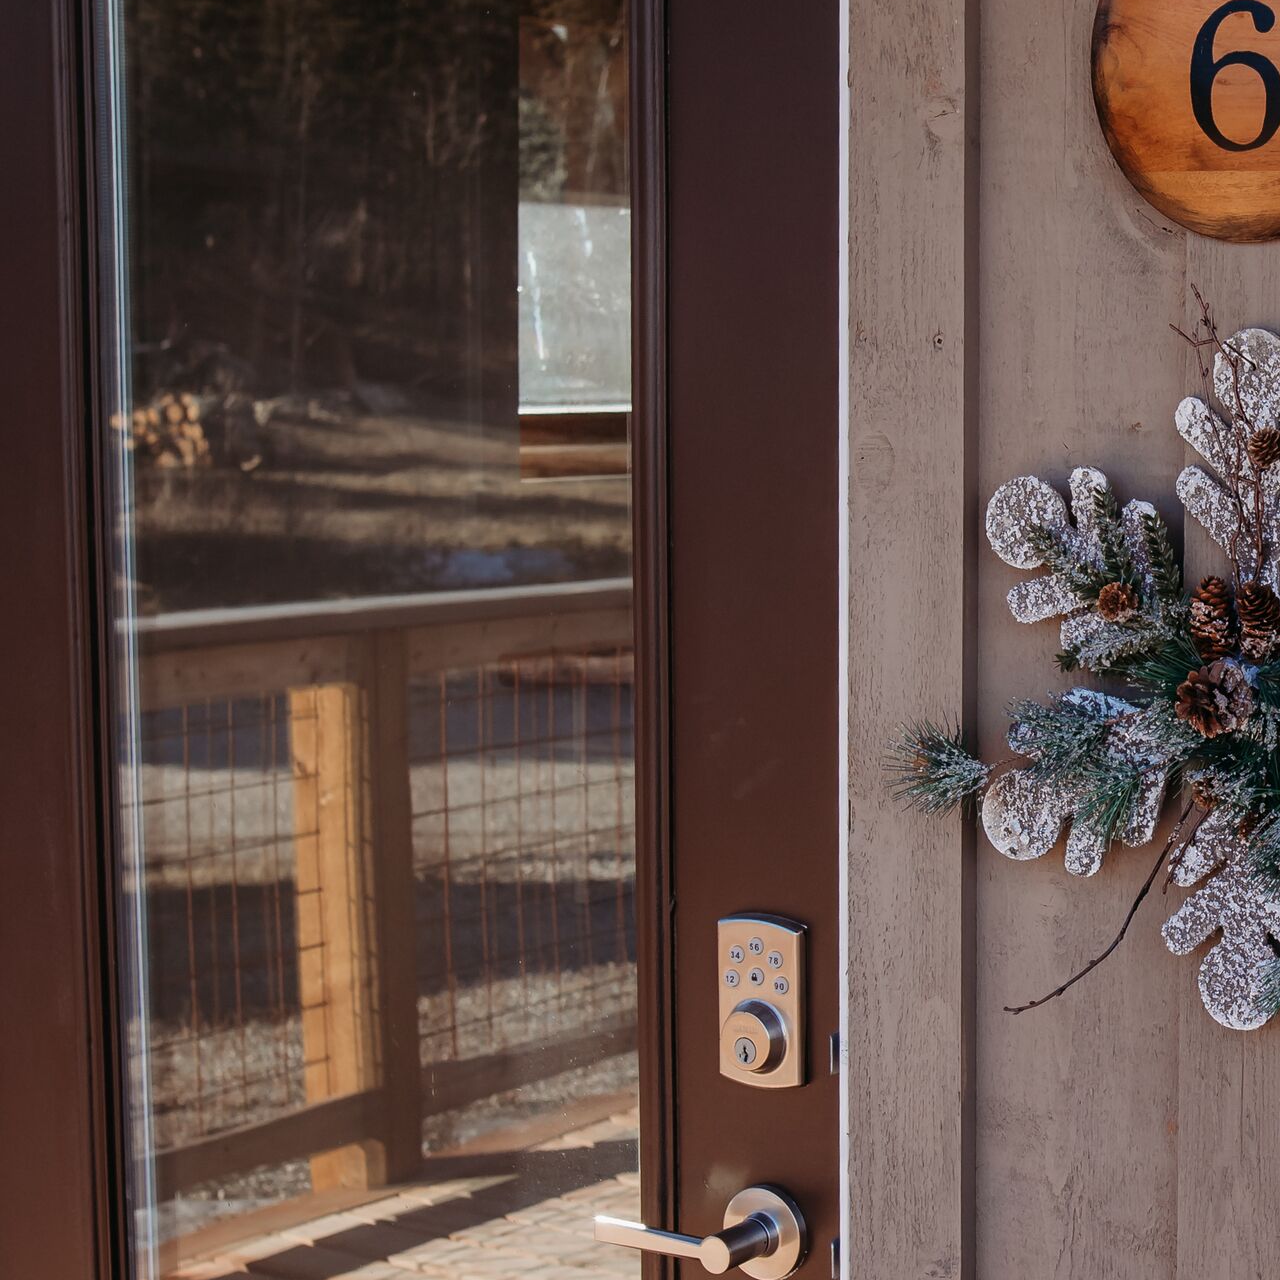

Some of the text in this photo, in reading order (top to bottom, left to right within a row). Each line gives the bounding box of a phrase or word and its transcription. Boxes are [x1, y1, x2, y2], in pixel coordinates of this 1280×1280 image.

[749, 941, 761, 952] 56
[730, 950, 741, 960] 34
[767, 955, 780, 966] 78
[725, 975, 736, 984] 12
[773, 981, 786, 992] 90
